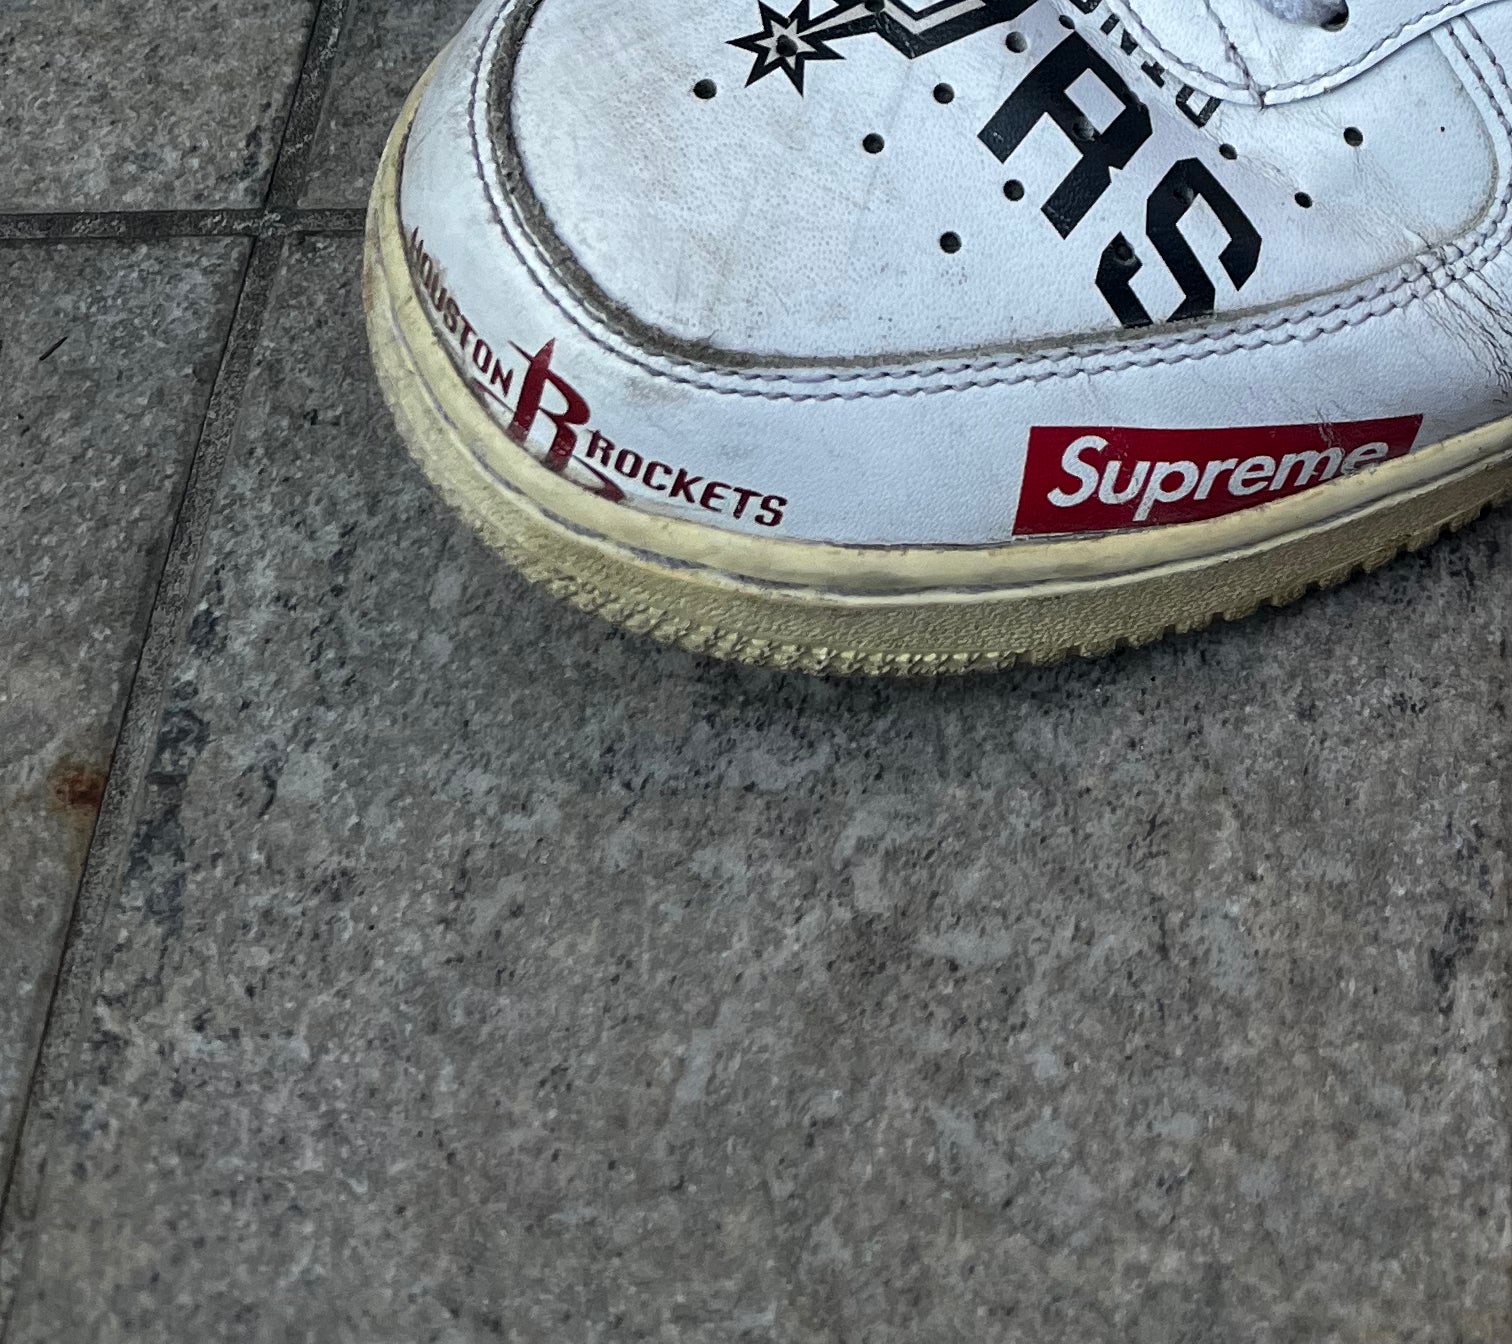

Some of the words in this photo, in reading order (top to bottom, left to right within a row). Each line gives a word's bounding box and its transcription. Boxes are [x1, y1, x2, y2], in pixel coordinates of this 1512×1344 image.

[409, 226, 514, 398] HOUSTON
[585, 428, 789, 528] ROCKETS
[1046, 434, 1390, 522] Supreme
